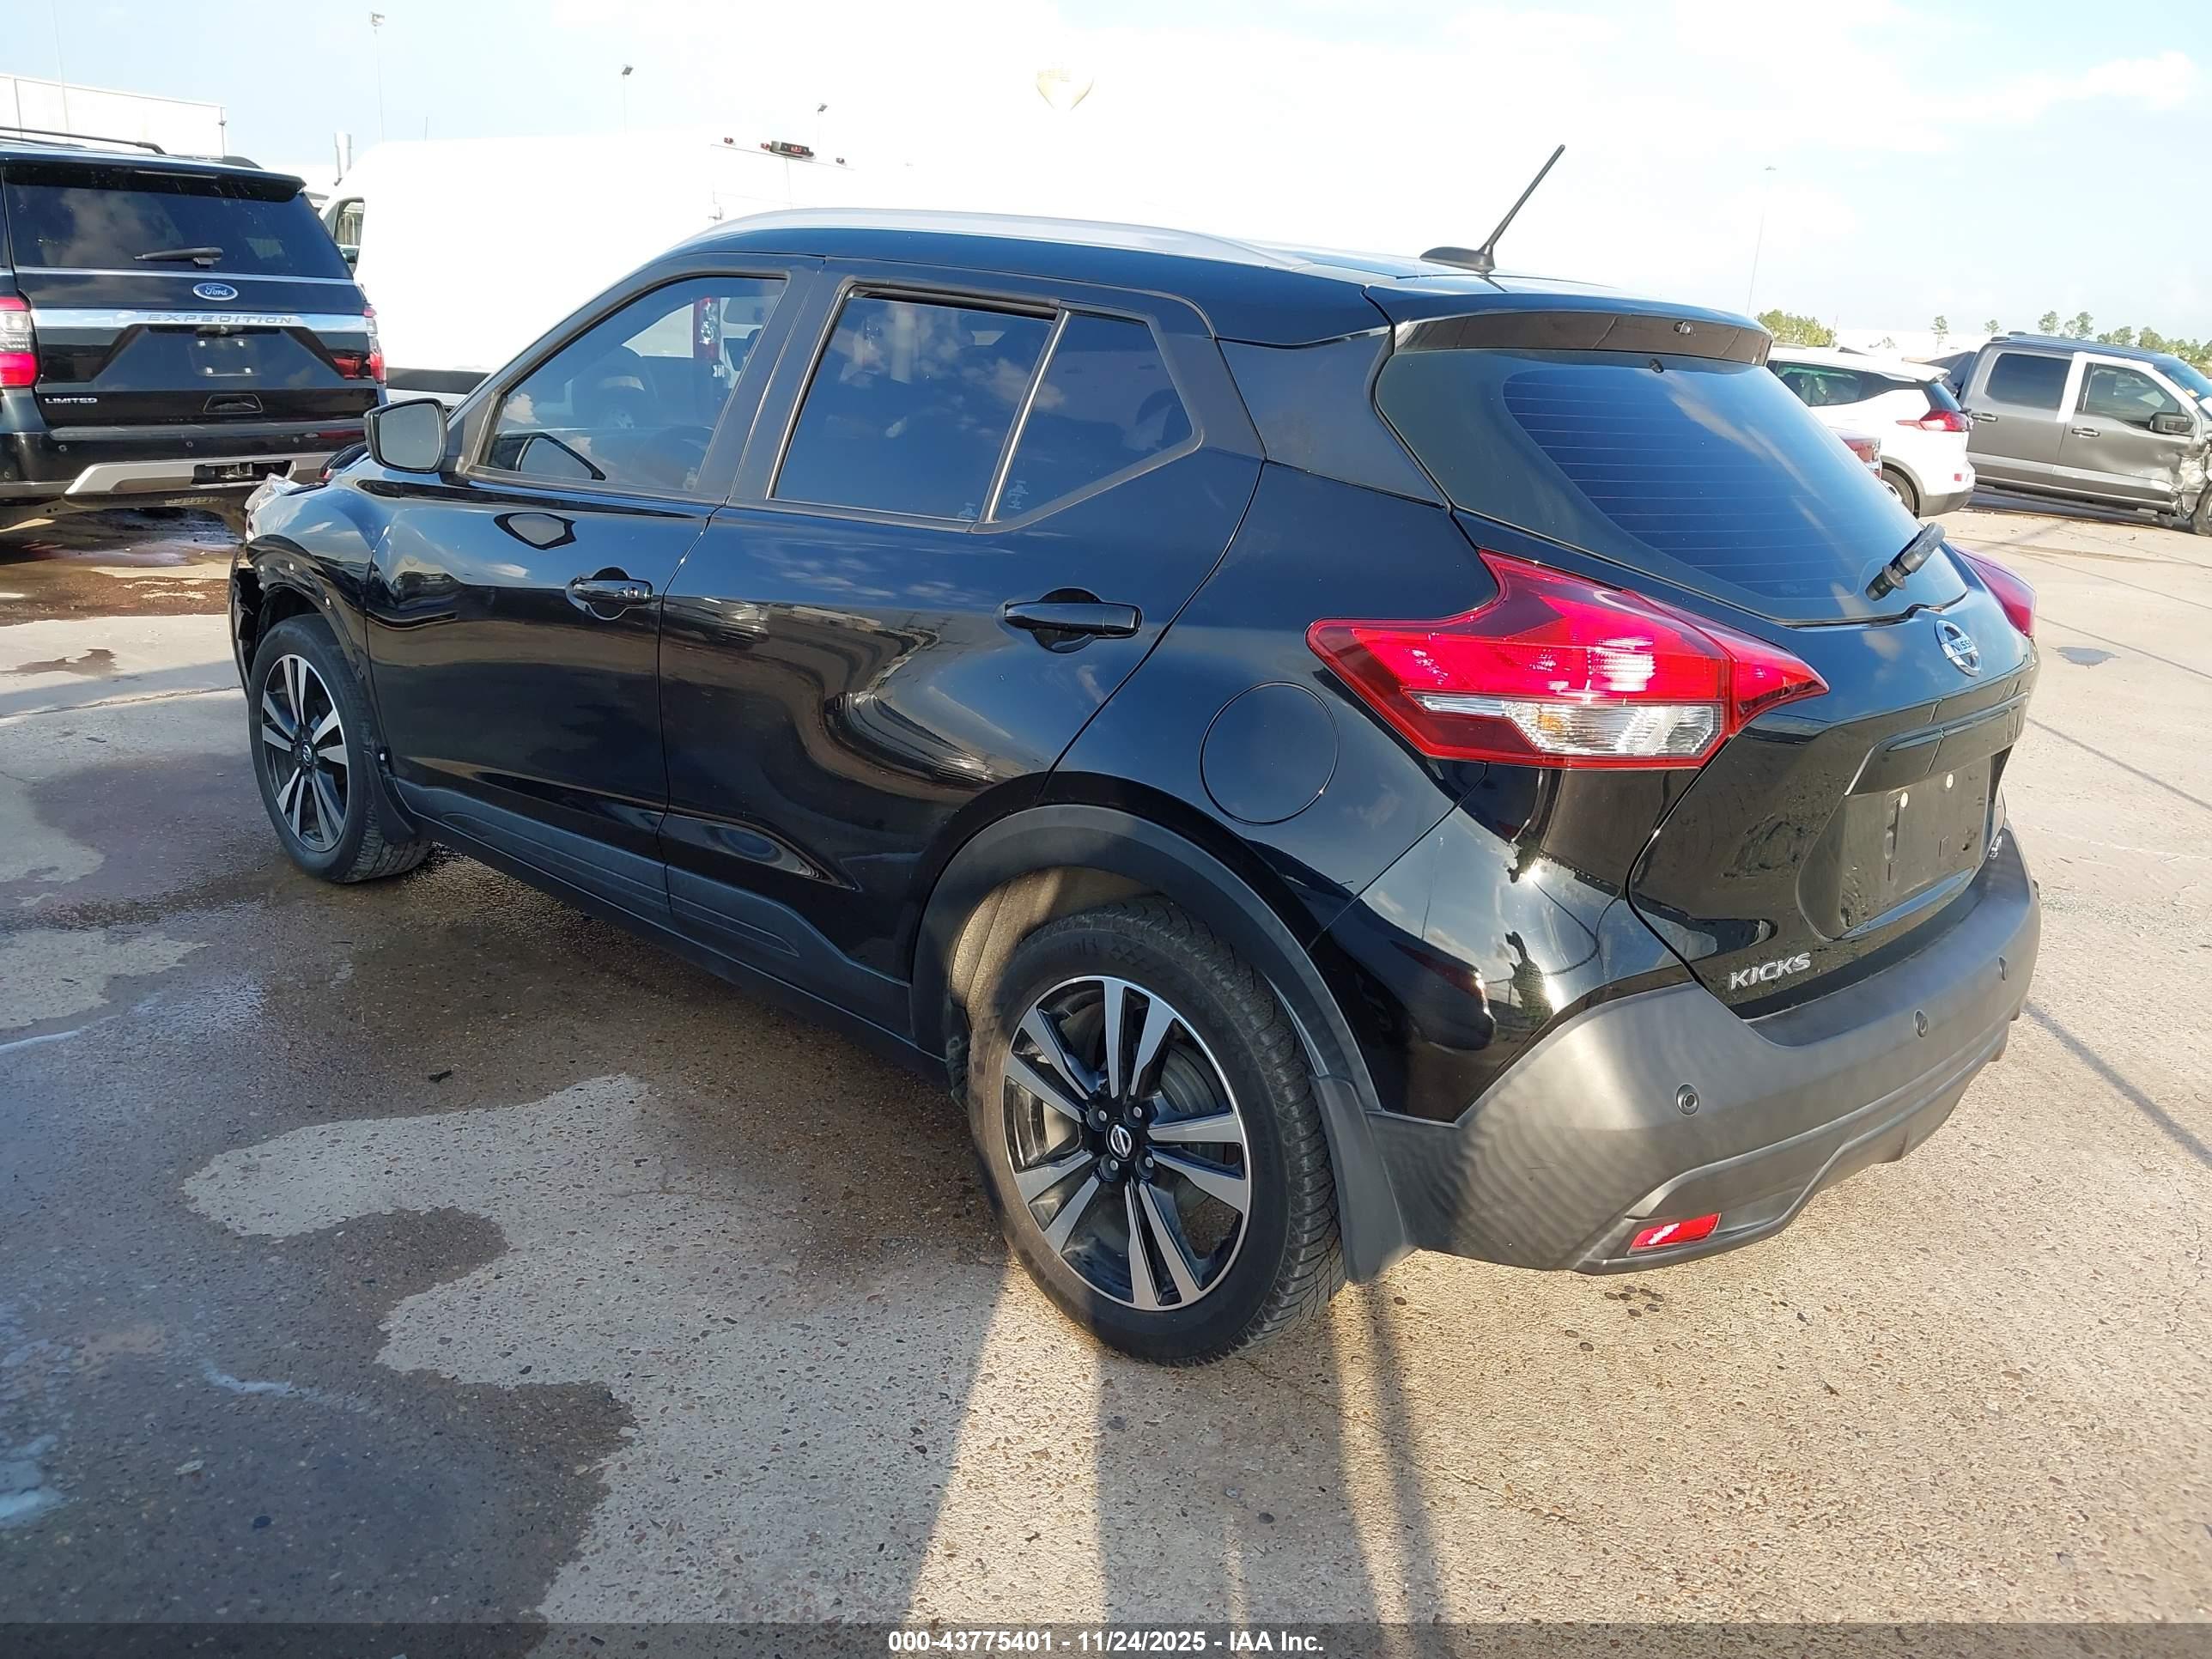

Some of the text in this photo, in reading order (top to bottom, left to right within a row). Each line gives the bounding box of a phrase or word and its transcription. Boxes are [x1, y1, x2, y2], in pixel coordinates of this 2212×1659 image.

[204, 285, 229, 296] Ford
[147, 313, 293, 325] EXPEDITION
[1729, 951, 1812, 991] KICKS
